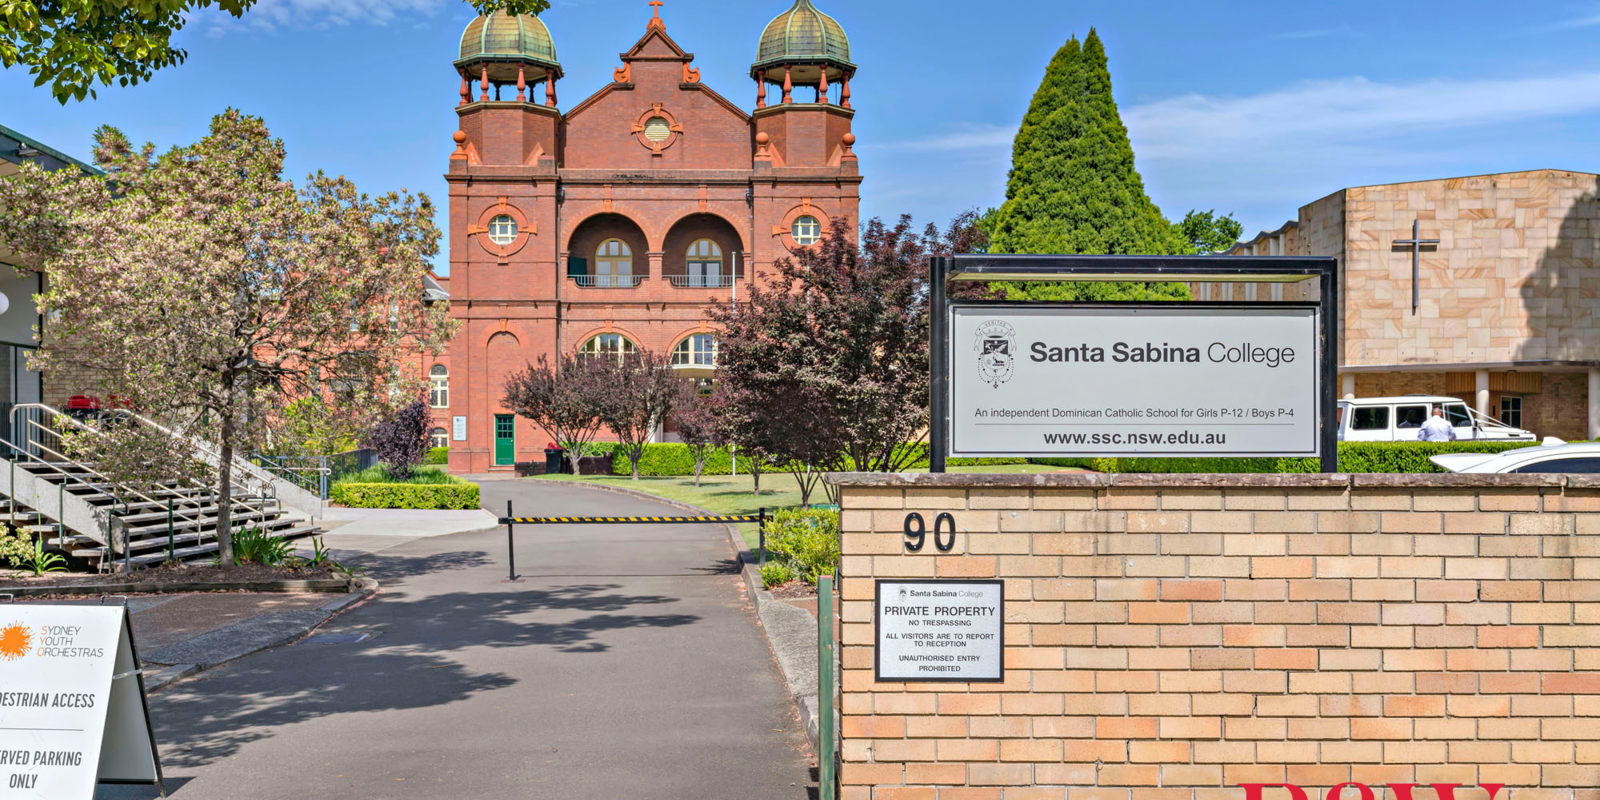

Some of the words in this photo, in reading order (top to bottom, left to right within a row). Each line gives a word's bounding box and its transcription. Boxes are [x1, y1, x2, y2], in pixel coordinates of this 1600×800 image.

[1030, 342, 1104, 362] Santa
[1112, 342, 1200, 363] Sabina
[1208, 342, 1295, 368] College
[975, 408, 988, 418] An
[991, 408, 1049, 419] independent
[1052, 408, 1102, 417] Dominican
[1105, 408, 1143, 417] Catholic
[1146, 408, 1178, 417] School
[1181, 408, 1194, 417] for
[1196, 408, 1218, 417] Girls
[1221, 408, 1243, 417] P-12
[1252, 408, 1275, 419] Boys
[1278, 408, 1294, 417] P-4
[1043, 430, 1225, 444] www.ssc.nsw.edu.au
[904, 512, 955, 551] 90
[958, 590, 983, 598] College
[885, 606, 929, 616] PRIVATE
[935, 606, 995, 616] PROPERTY
[41, 626, 81, 635] SYDNEY
[40, 636, 73, 646] YOUTH
[37, 647, 103, 657] ORCHESTRAS
[51, 693, 95, 708] ACCESS
[0, 750, 30, 765] RVED
[33, 751, 82, 766] PARKING
[9, 774, 38, 789] ONLY
